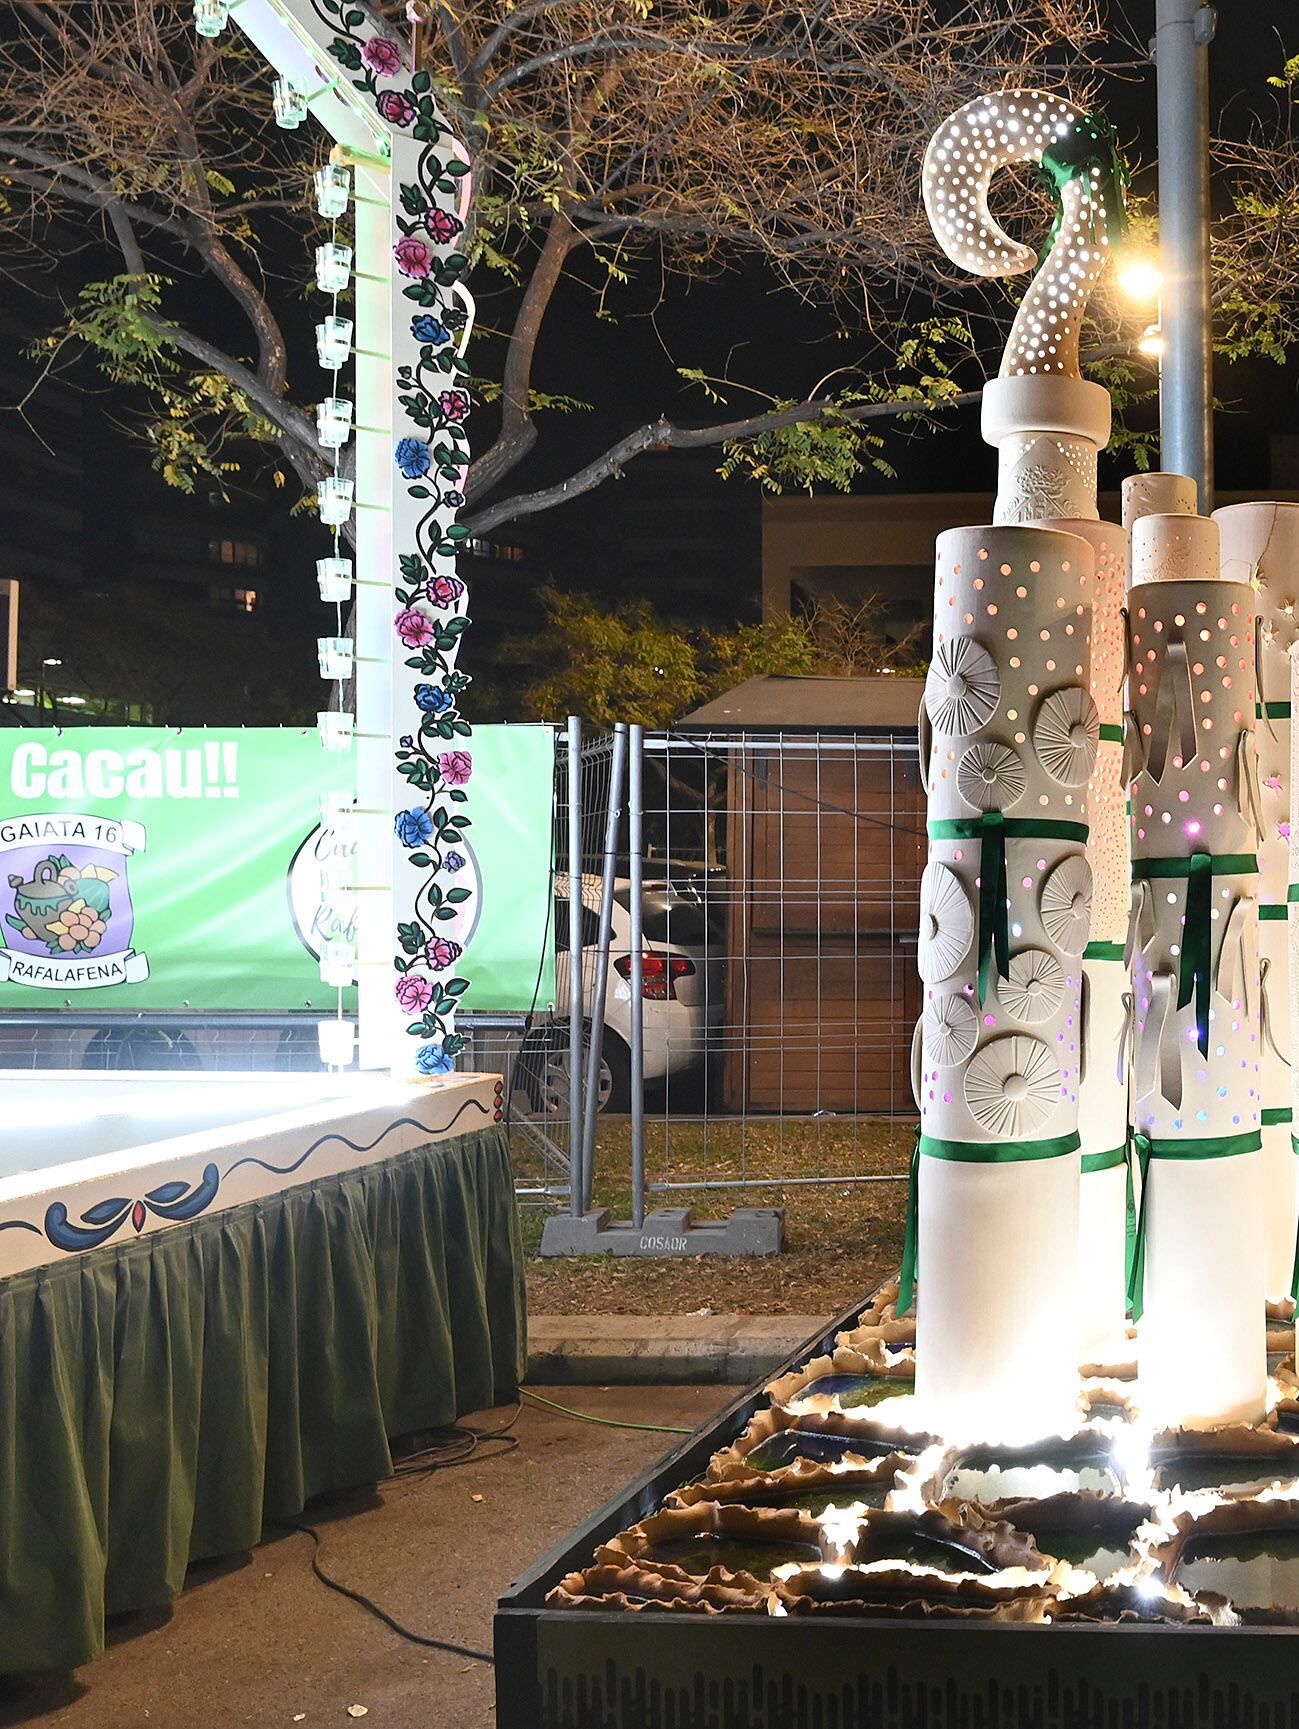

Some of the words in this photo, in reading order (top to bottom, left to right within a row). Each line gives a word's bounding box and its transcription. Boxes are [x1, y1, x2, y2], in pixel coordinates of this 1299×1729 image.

[10, 741, 240, 799] Cacau!!
[0, 820, 86, 843] GAIATA
[94, 824, 118, 843] 16
[12, 961, 123, 982] RAFALAFENA
[640, 1236, 688, 1251] COSAOR
